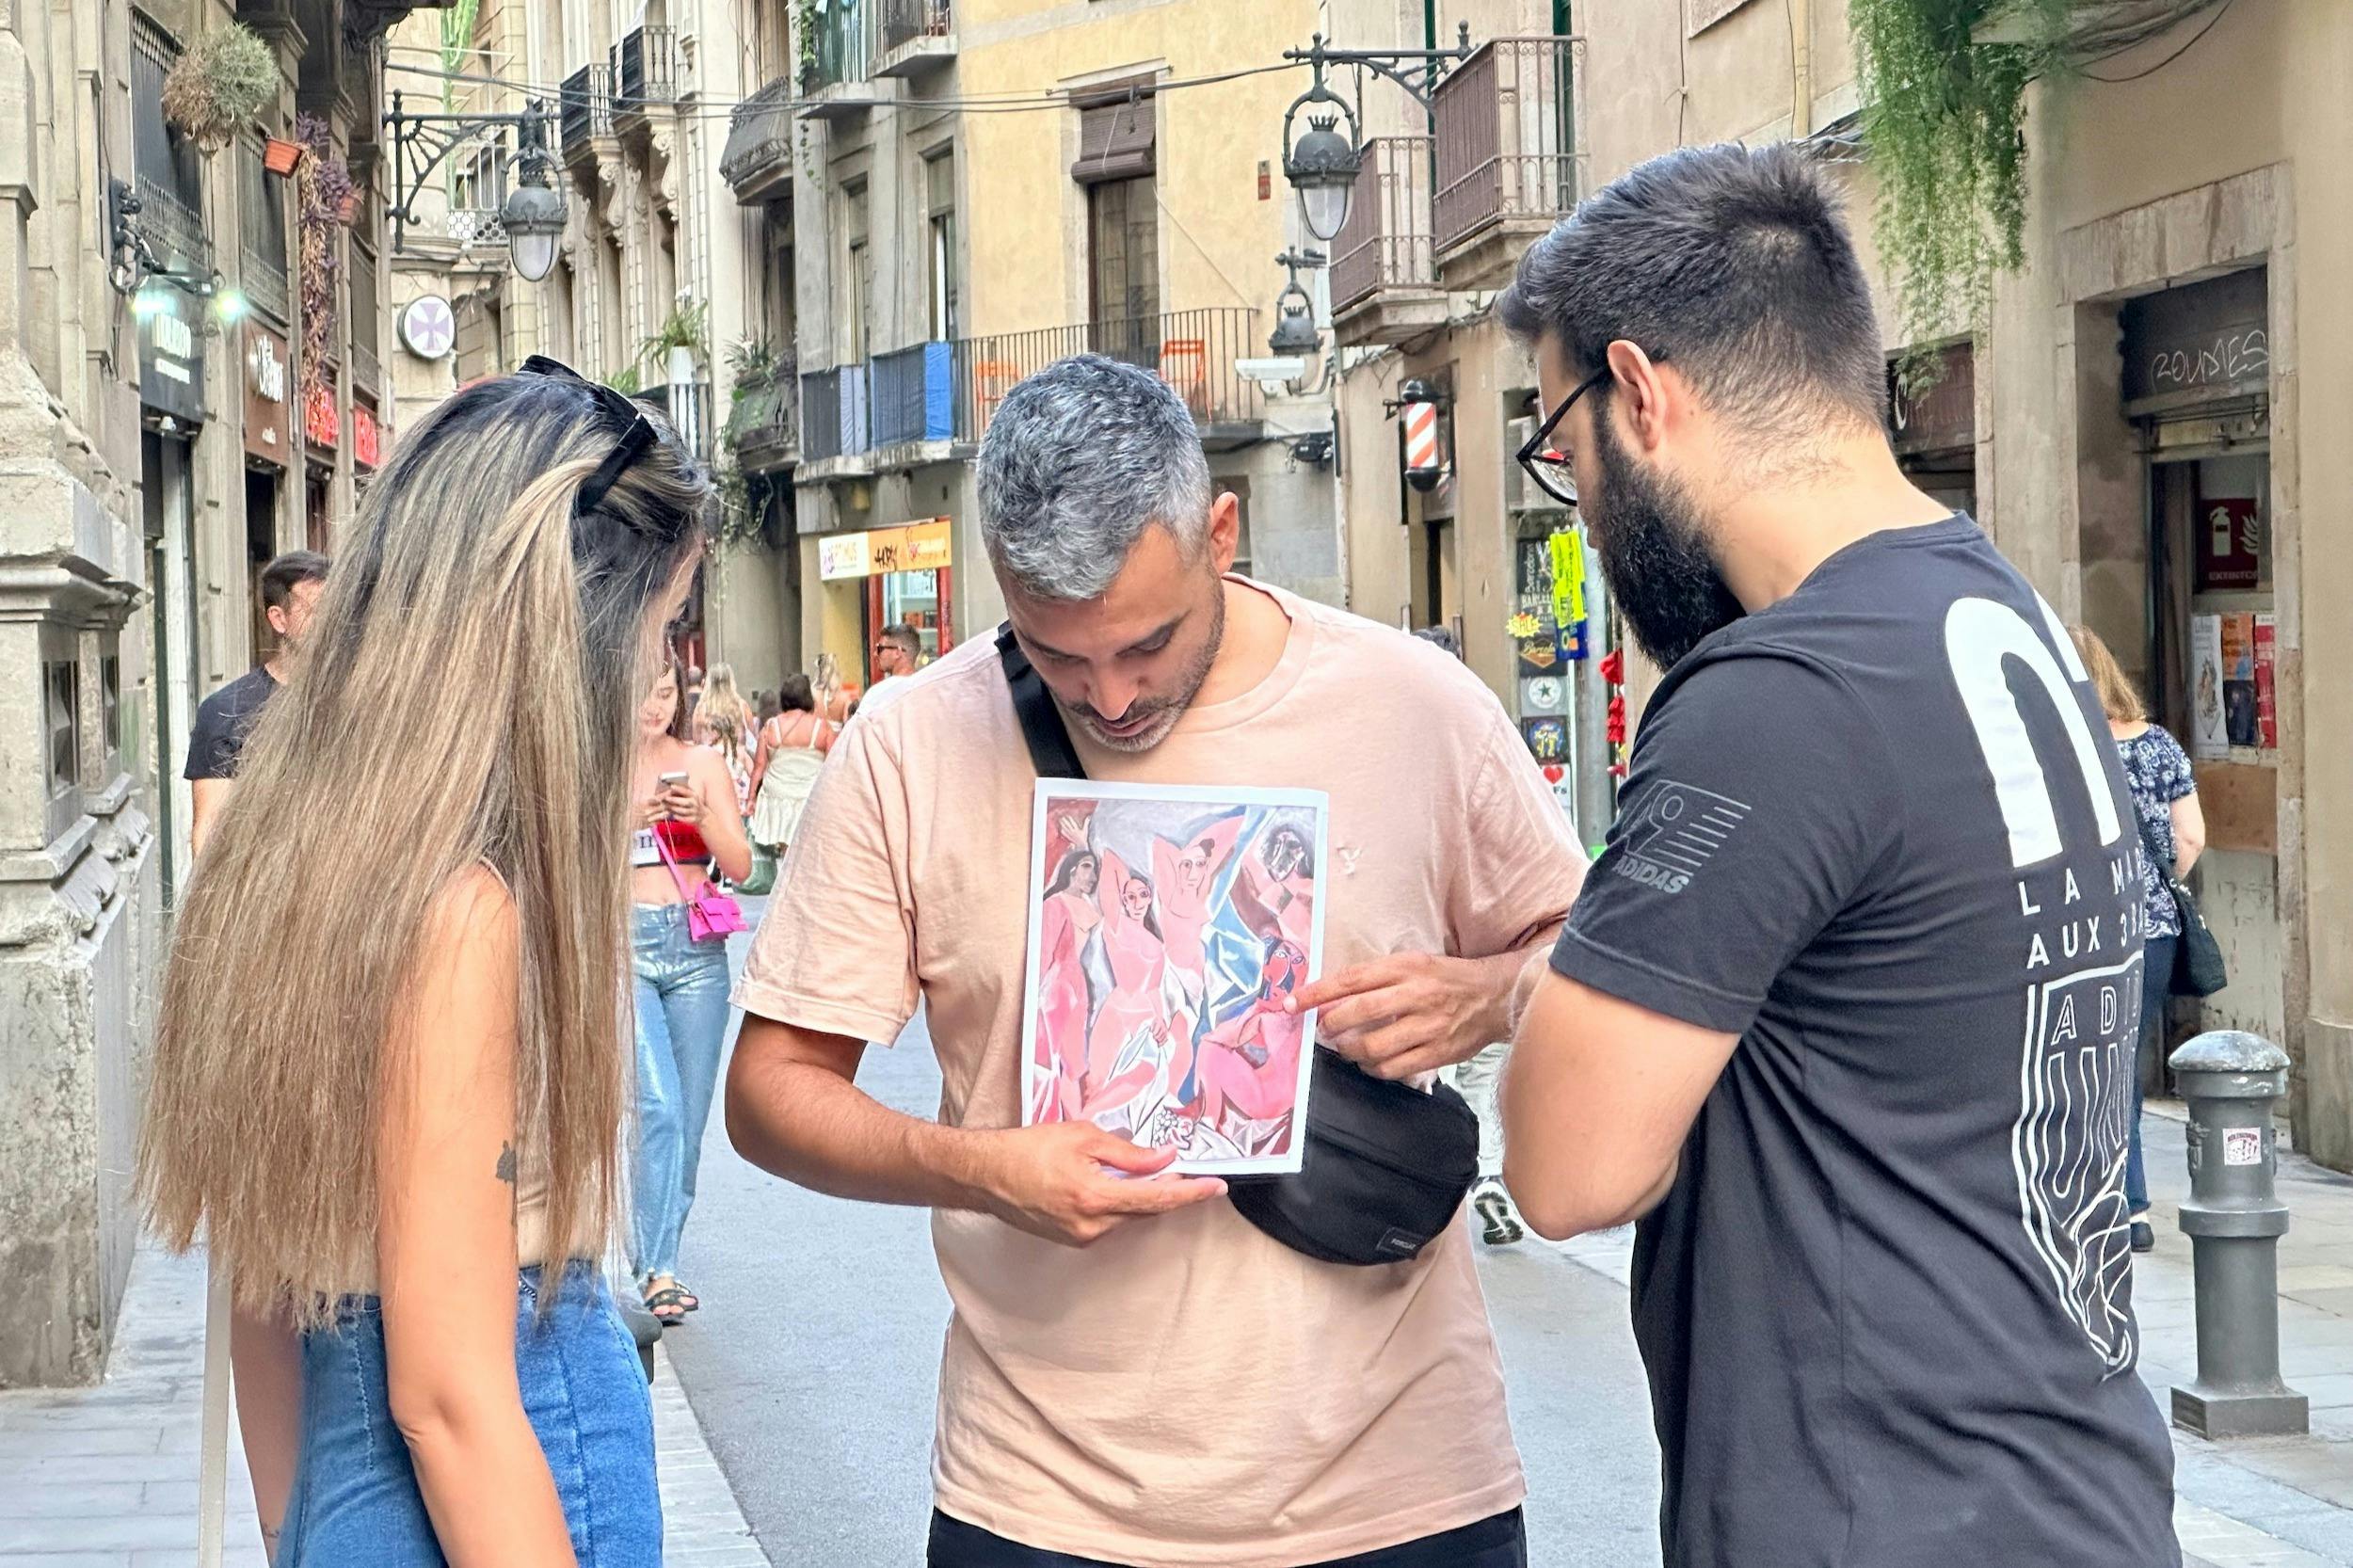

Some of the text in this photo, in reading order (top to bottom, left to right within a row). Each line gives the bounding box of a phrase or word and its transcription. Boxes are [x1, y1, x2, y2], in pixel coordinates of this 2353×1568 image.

[1611, 855, 1689, 893] ADIDAS
[2018, 867, 2081, 916] LA
[2026, 915, 2101, 969] AUX
